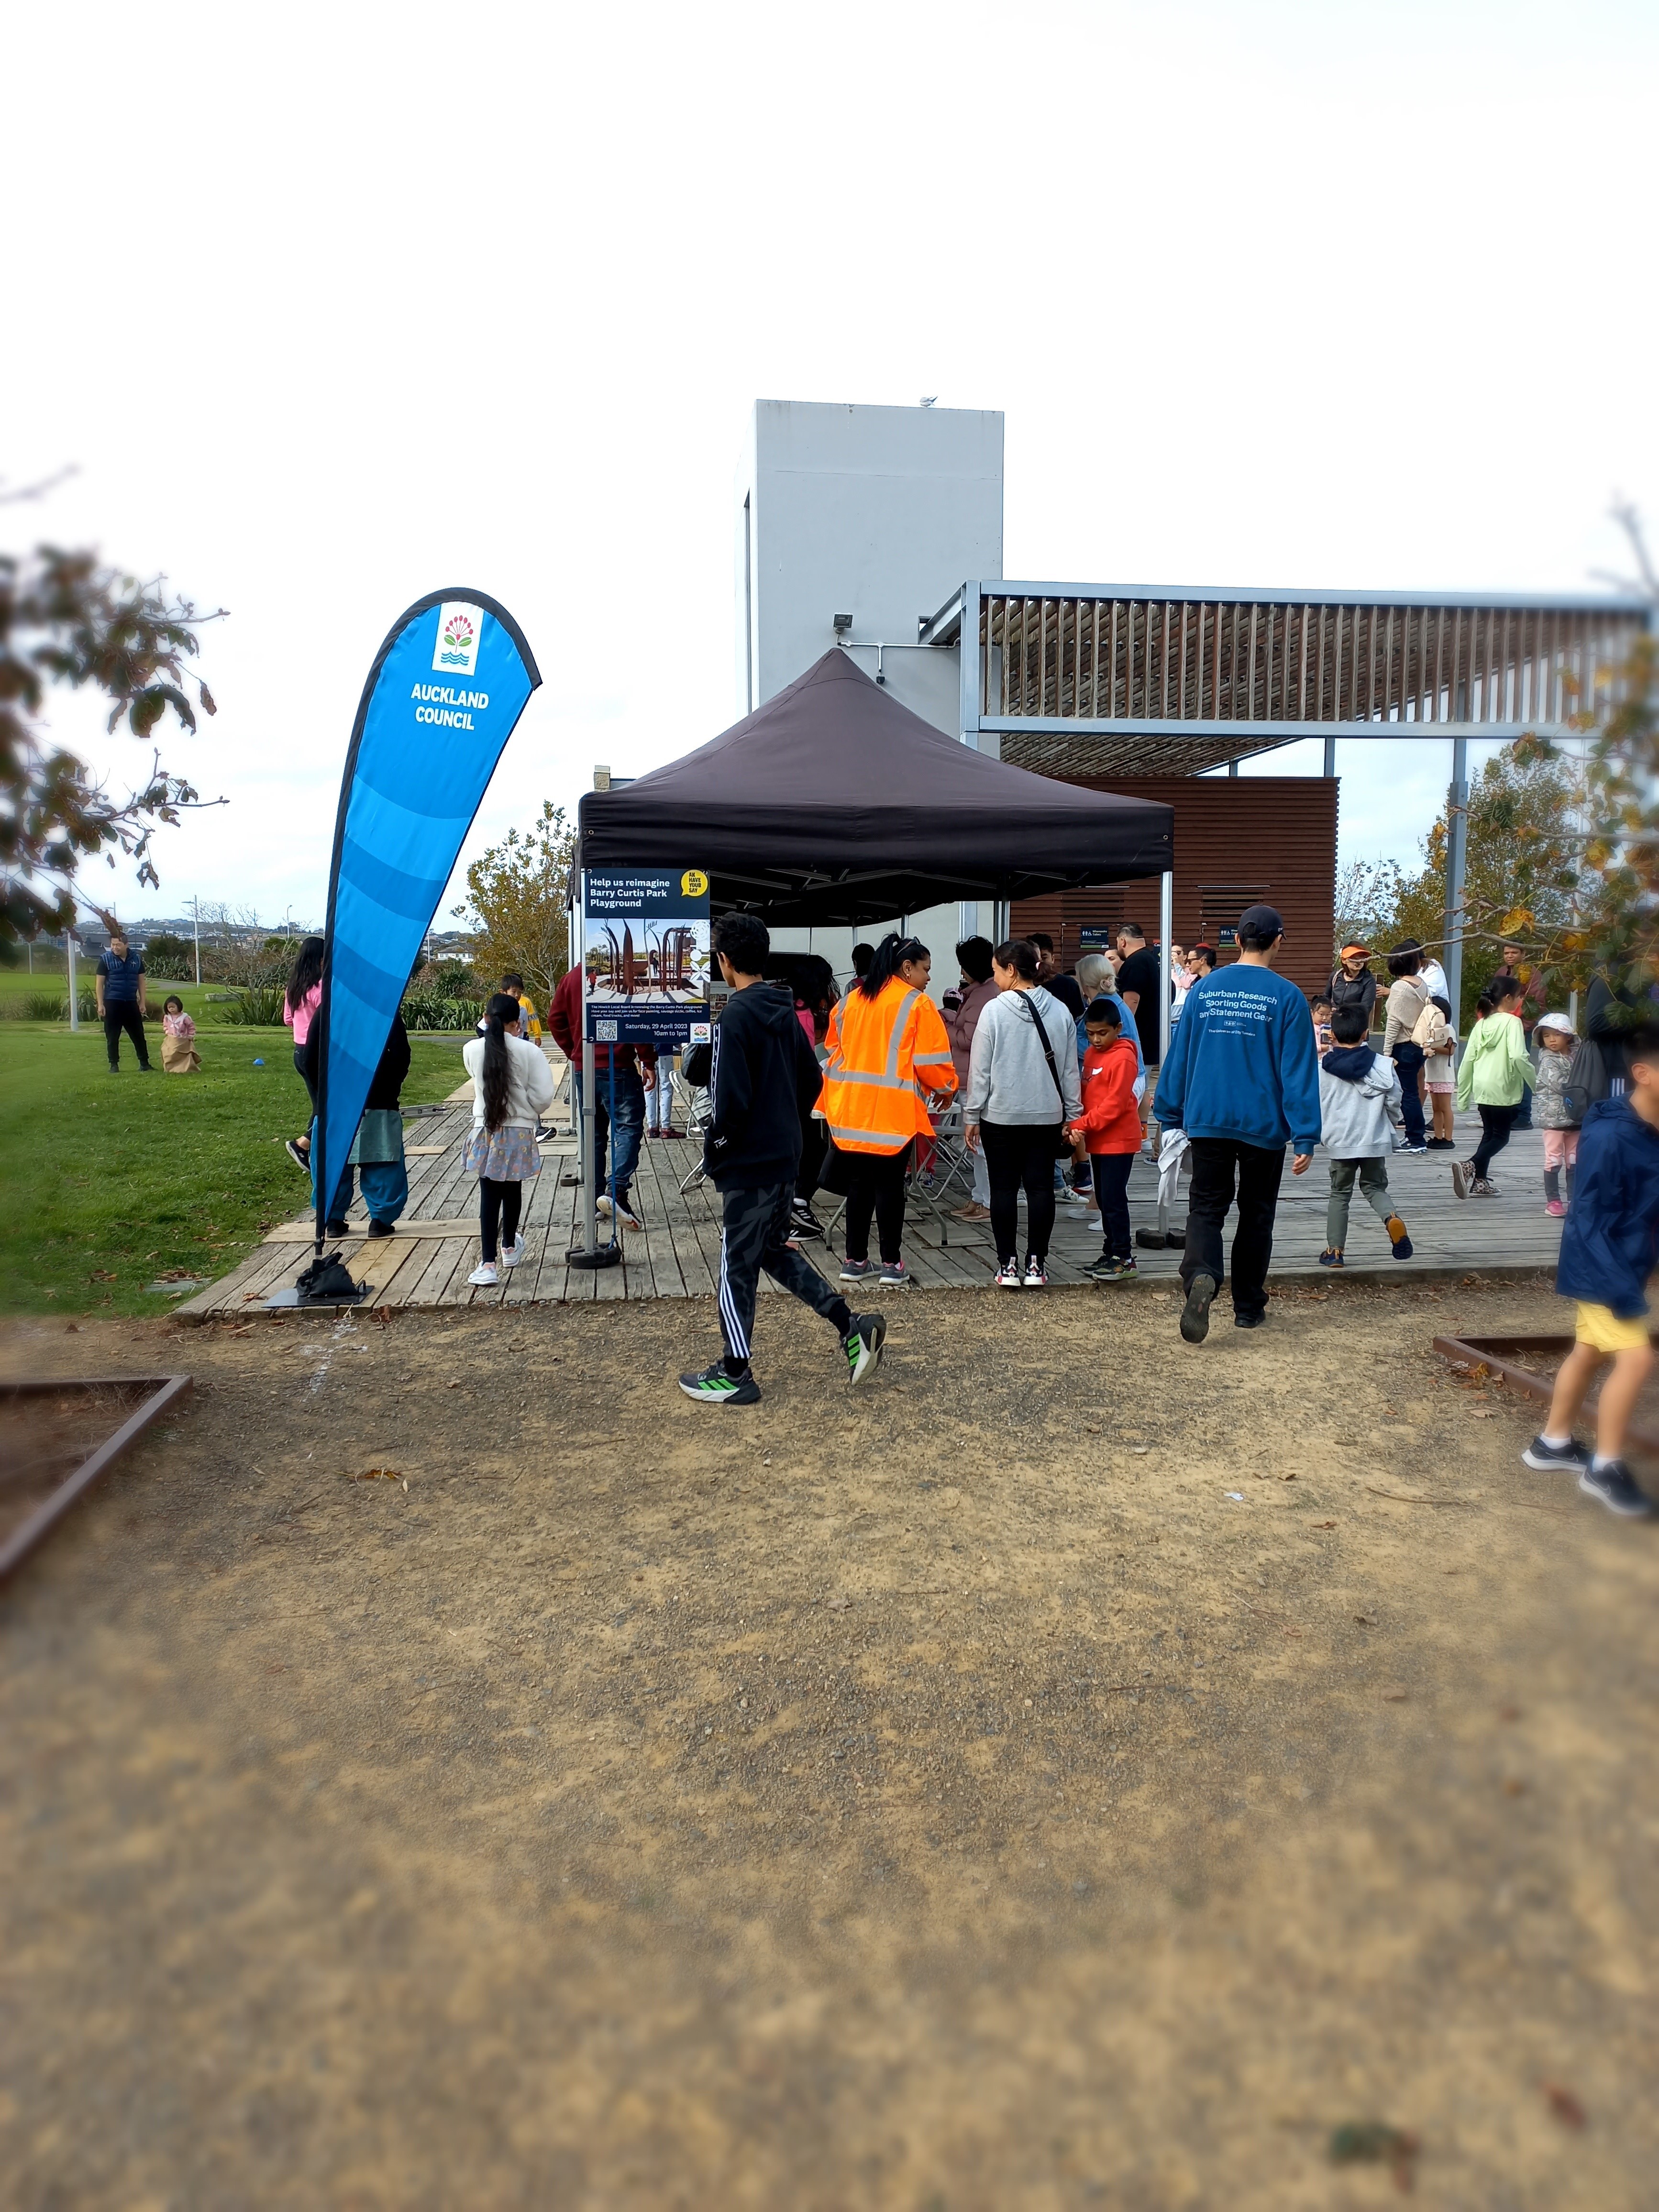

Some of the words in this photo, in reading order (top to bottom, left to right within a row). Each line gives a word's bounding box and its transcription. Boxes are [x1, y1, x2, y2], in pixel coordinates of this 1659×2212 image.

[410, 683, 489, 709] AUCKLAND
[415, 706, 475, 731] COUNCIL
[590, 878, 611, 887] Help
[626, 879, 670, 888] reimagine
[590, 889, 615, 898] Barry
[590, 899, 641, 908] Playground
[1198, 990, 1237, 999] Suburban
[1238, 991, 1278, 1005] Research
[1206, 999, 1239, 1009] Sporting
[1240, 1000, 1267, 1011] Goods
[1210, 1008, 1252, 1018] Statement
[1253, 1012, 1273, 1022] Gear
